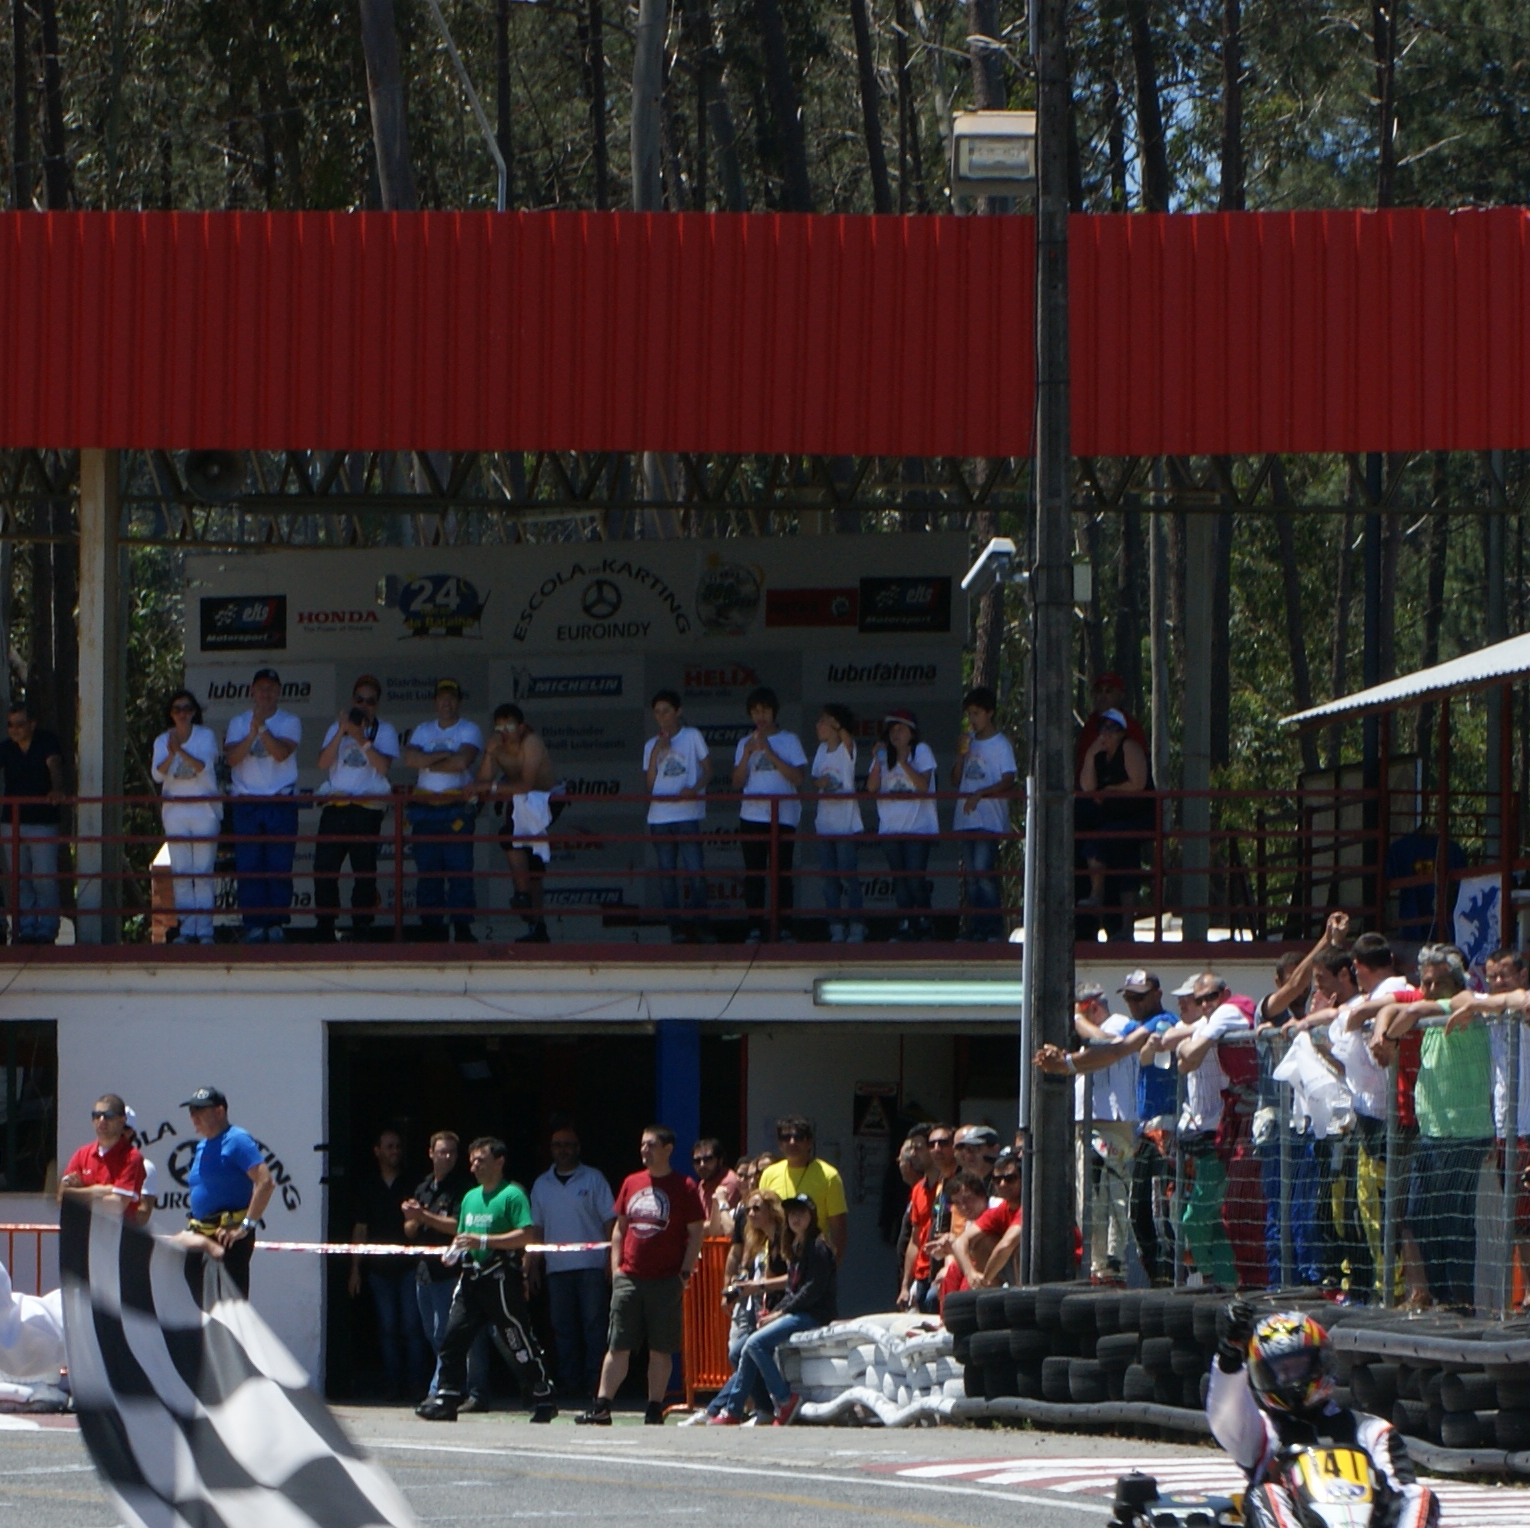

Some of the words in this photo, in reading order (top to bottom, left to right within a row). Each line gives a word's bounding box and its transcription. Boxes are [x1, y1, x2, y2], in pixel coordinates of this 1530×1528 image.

[410, 577, 461, 612] 24
[513, 562, 587, 642] ESCOLA
[603, 559, 691, 635] KARTING
[297, 609, 380, 625] HONDA
[557, 621, 651, 641] EUROINDY
[534, 678, 619, 693] MICHELIN
[684, 668, 758, 687] HELIX
